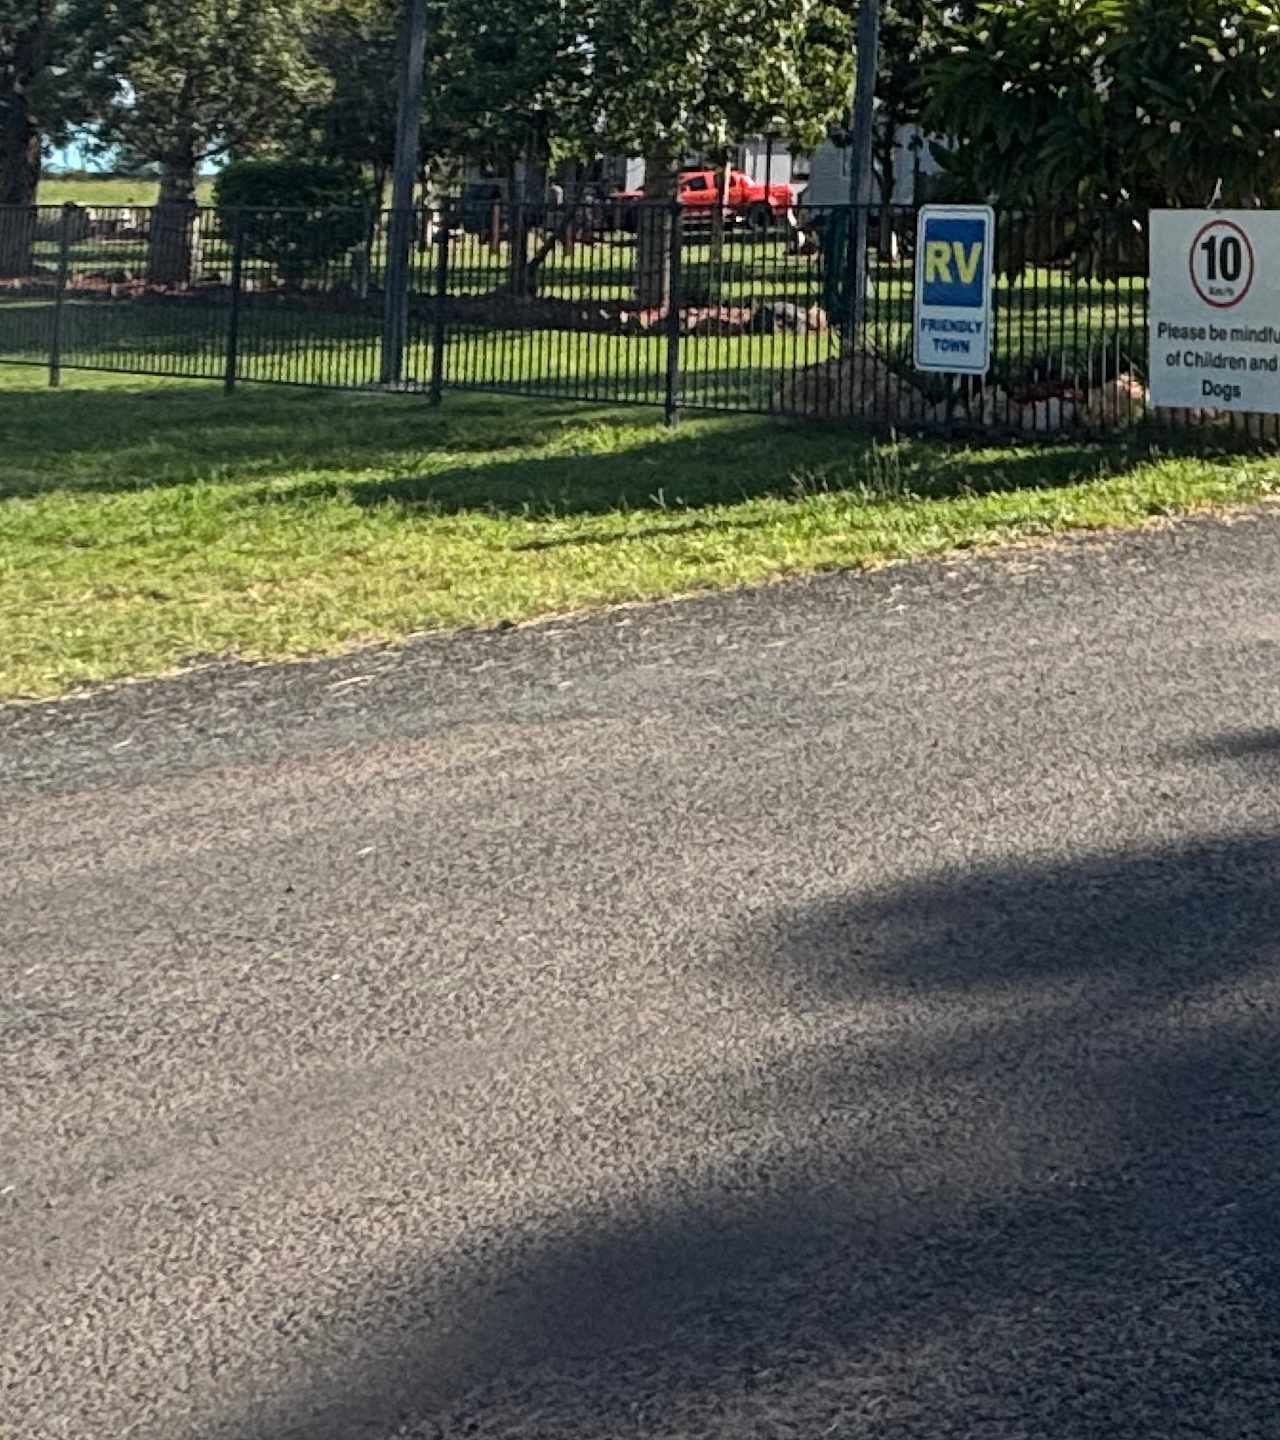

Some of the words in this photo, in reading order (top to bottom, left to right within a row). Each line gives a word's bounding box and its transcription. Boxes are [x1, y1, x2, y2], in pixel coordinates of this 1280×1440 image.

[925, 241, 983, 284] RV
[1200, 235, 1242, 281] 10
[921, 318, 984, 334] FRIENDLY
[1158, 322, 1206, 340] Please
[1209, 324, 1227, 340] be
[932, 338, 970, 353] TOWN
[1166, 350, 1181, 366] of
[1183, 351, 1247, 369] Children
[1249, 354, 1278, 372] and
[1202, 380, 1241, 401] Dogs
